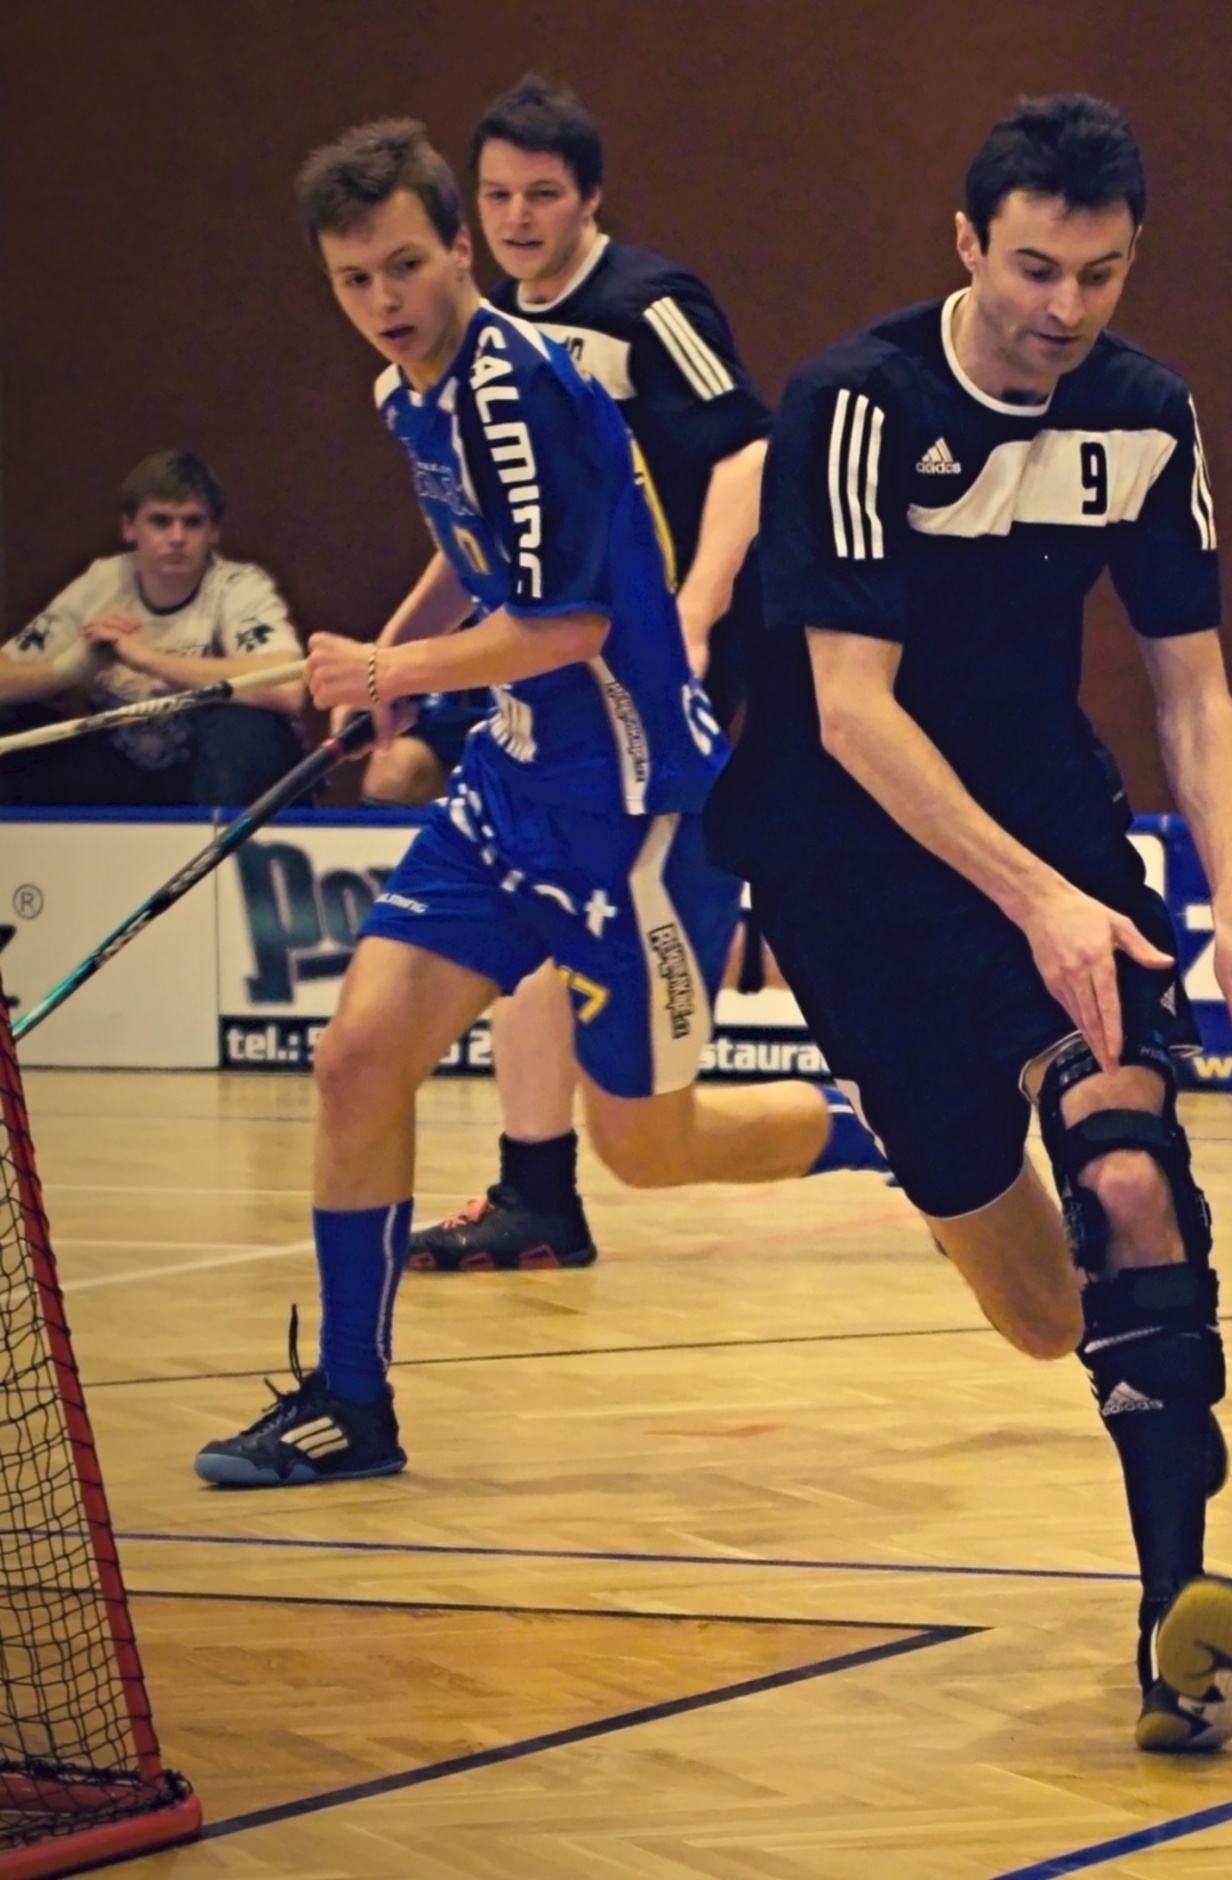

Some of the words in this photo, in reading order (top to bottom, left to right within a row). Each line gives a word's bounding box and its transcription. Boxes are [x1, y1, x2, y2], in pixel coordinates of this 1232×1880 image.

[915, 460, 962, 475] adidas
[1080, 441, 1107, 515] 9
[227, 1026, 299, 1061] tel.:
